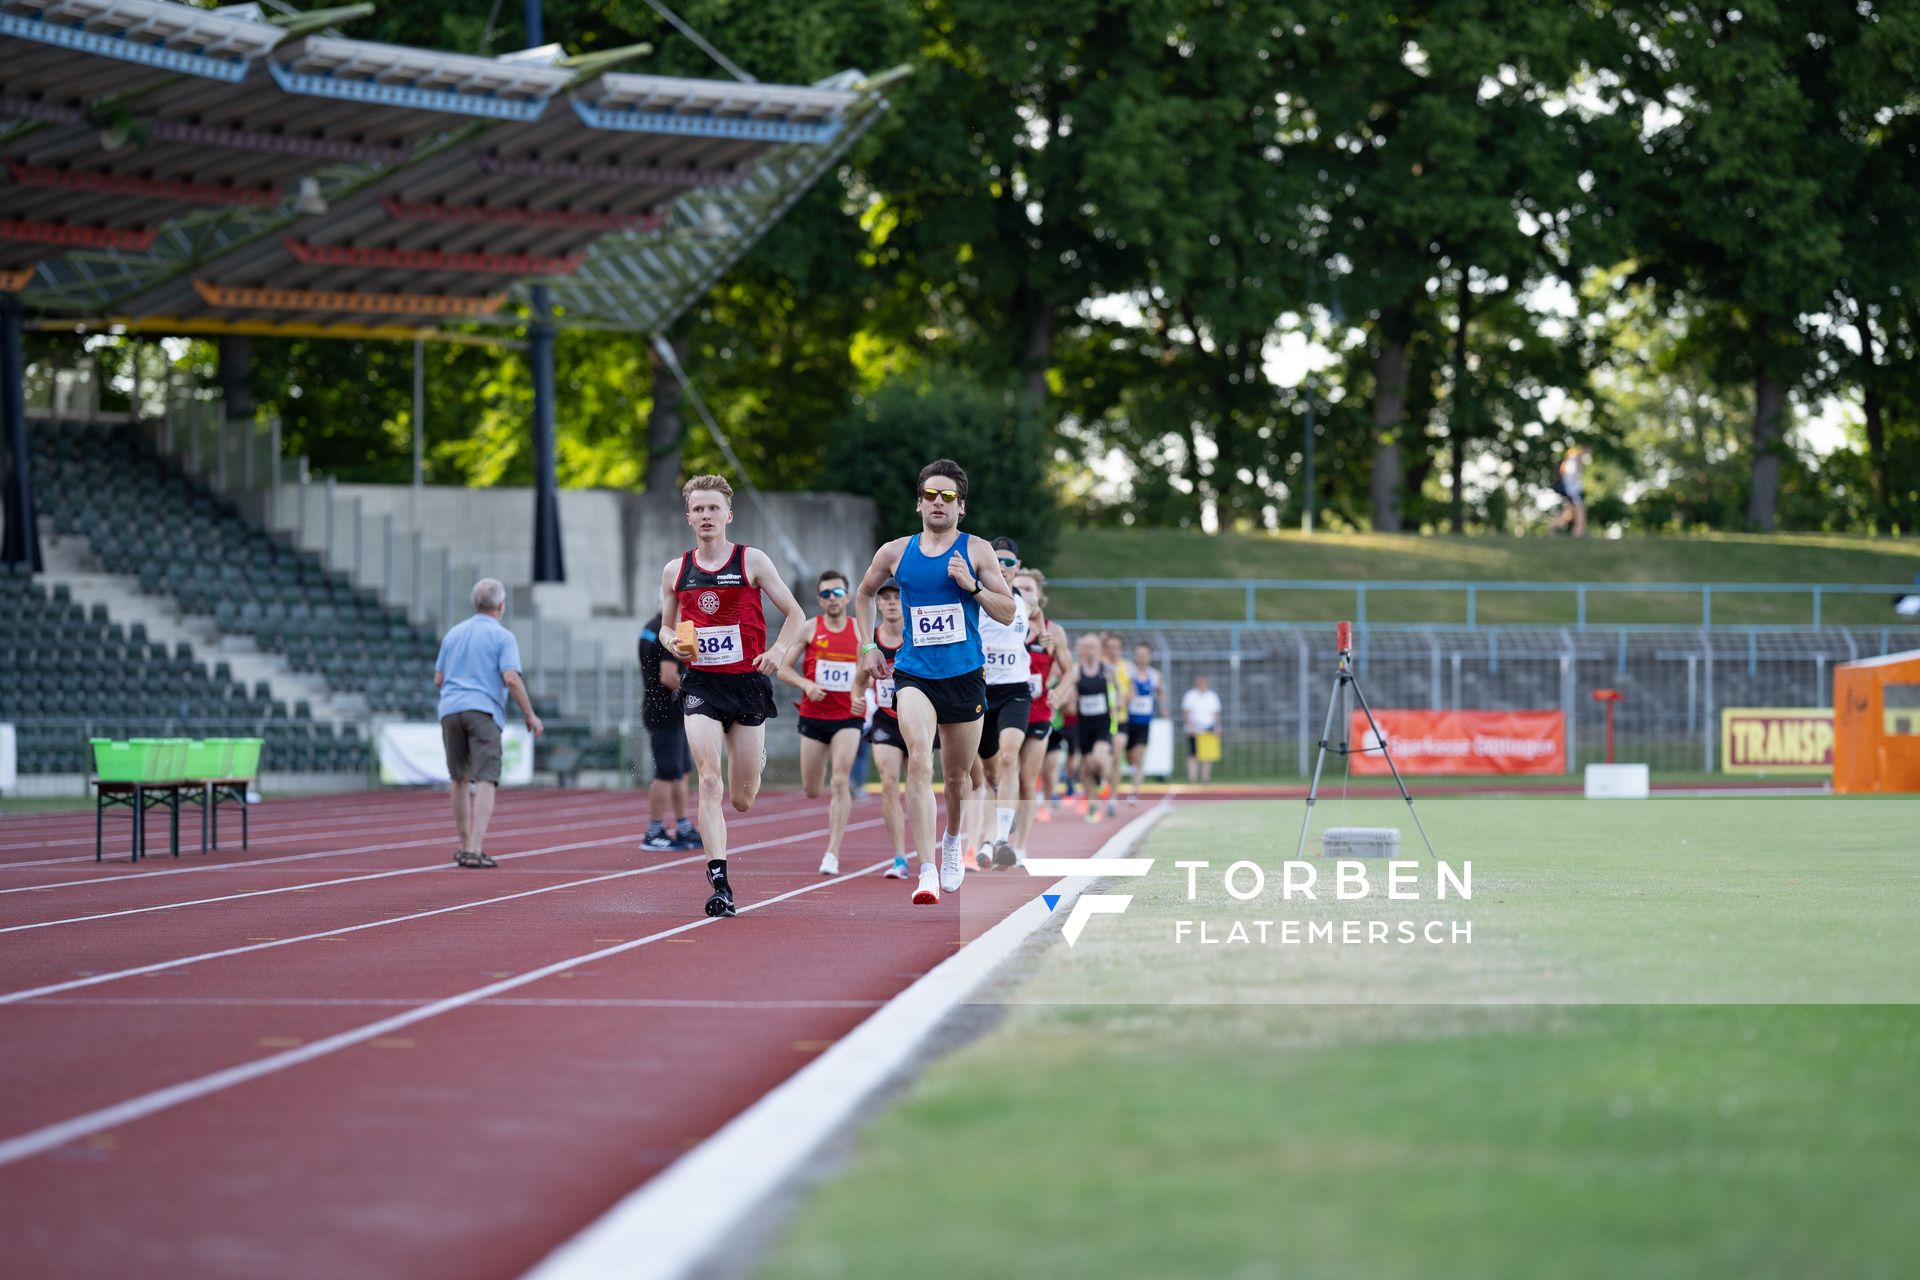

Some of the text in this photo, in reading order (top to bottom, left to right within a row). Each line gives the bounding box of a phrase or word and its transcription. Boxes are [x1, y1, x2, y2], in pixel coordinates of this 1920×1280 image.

[919, 614, 955, 633] 641
[698, 635, 734, 653] 384
[987, 653, 1016, 665] 510
[822, 669, 849, 682] 101
[1390, 734, 1470, 758] Sparkasse
[1732, 719, 1834, 765] TRANSP
